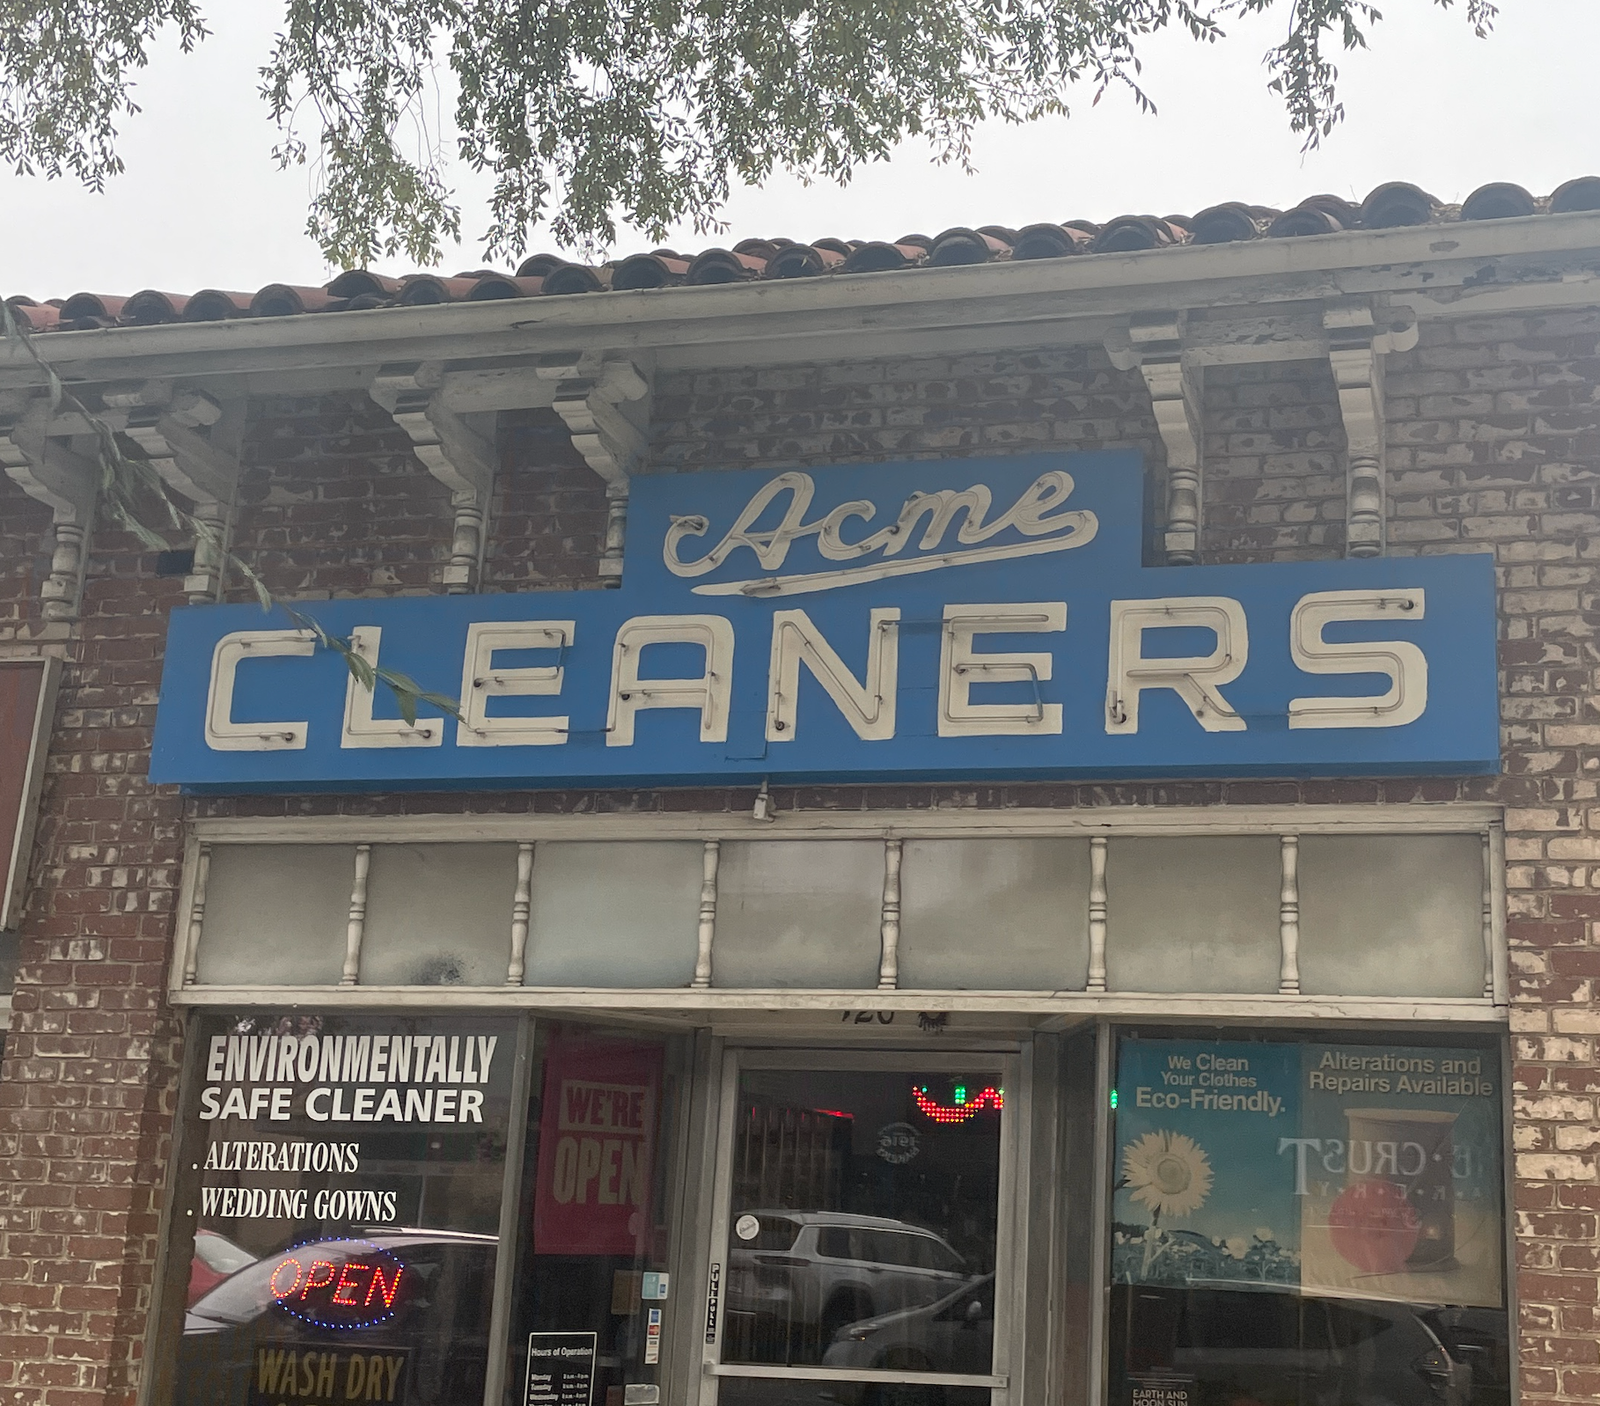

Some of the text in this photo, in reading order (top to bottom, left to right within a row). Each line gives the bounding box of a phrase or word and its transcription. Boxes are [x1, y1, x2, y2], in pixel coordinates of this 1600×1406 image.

[663, 470, 1098, 597] Acme
[205, 588, 1427, 750] CLEANERS
[206, 1035, 497, 1083] ENVIRONMENTALLY
[1168, 1053, 1248, 1071] We Clean
[1319, 1051, 1481, 1075] Alterations and
[1160, 1071, 1257, 1088] Your Clothes
[1309, 1071, 1493, 1096] Repairs Available
[199, 1087, 484, 1123] SAFE CLEANER
[565, 1085, 645, 1128] WE'RE
[1136, 1086, 1286, 1117] Eco-Friendly.
[203, 1140, 359, 1173] ALTERATIONS
[553, 1135, 648, 1205] OPEN
[201, 1187, 397, 1221] WEDDING GOWNS
[270, 1258, 404, 1308] OPEN
[531, 1347, 592, 1358] Hours of Operation
[258, 1349, 337, 1398] WASH
[346, 1353, 404, 1402] DRY
[1132, 1389, 1188, 1400] EARTH AND
